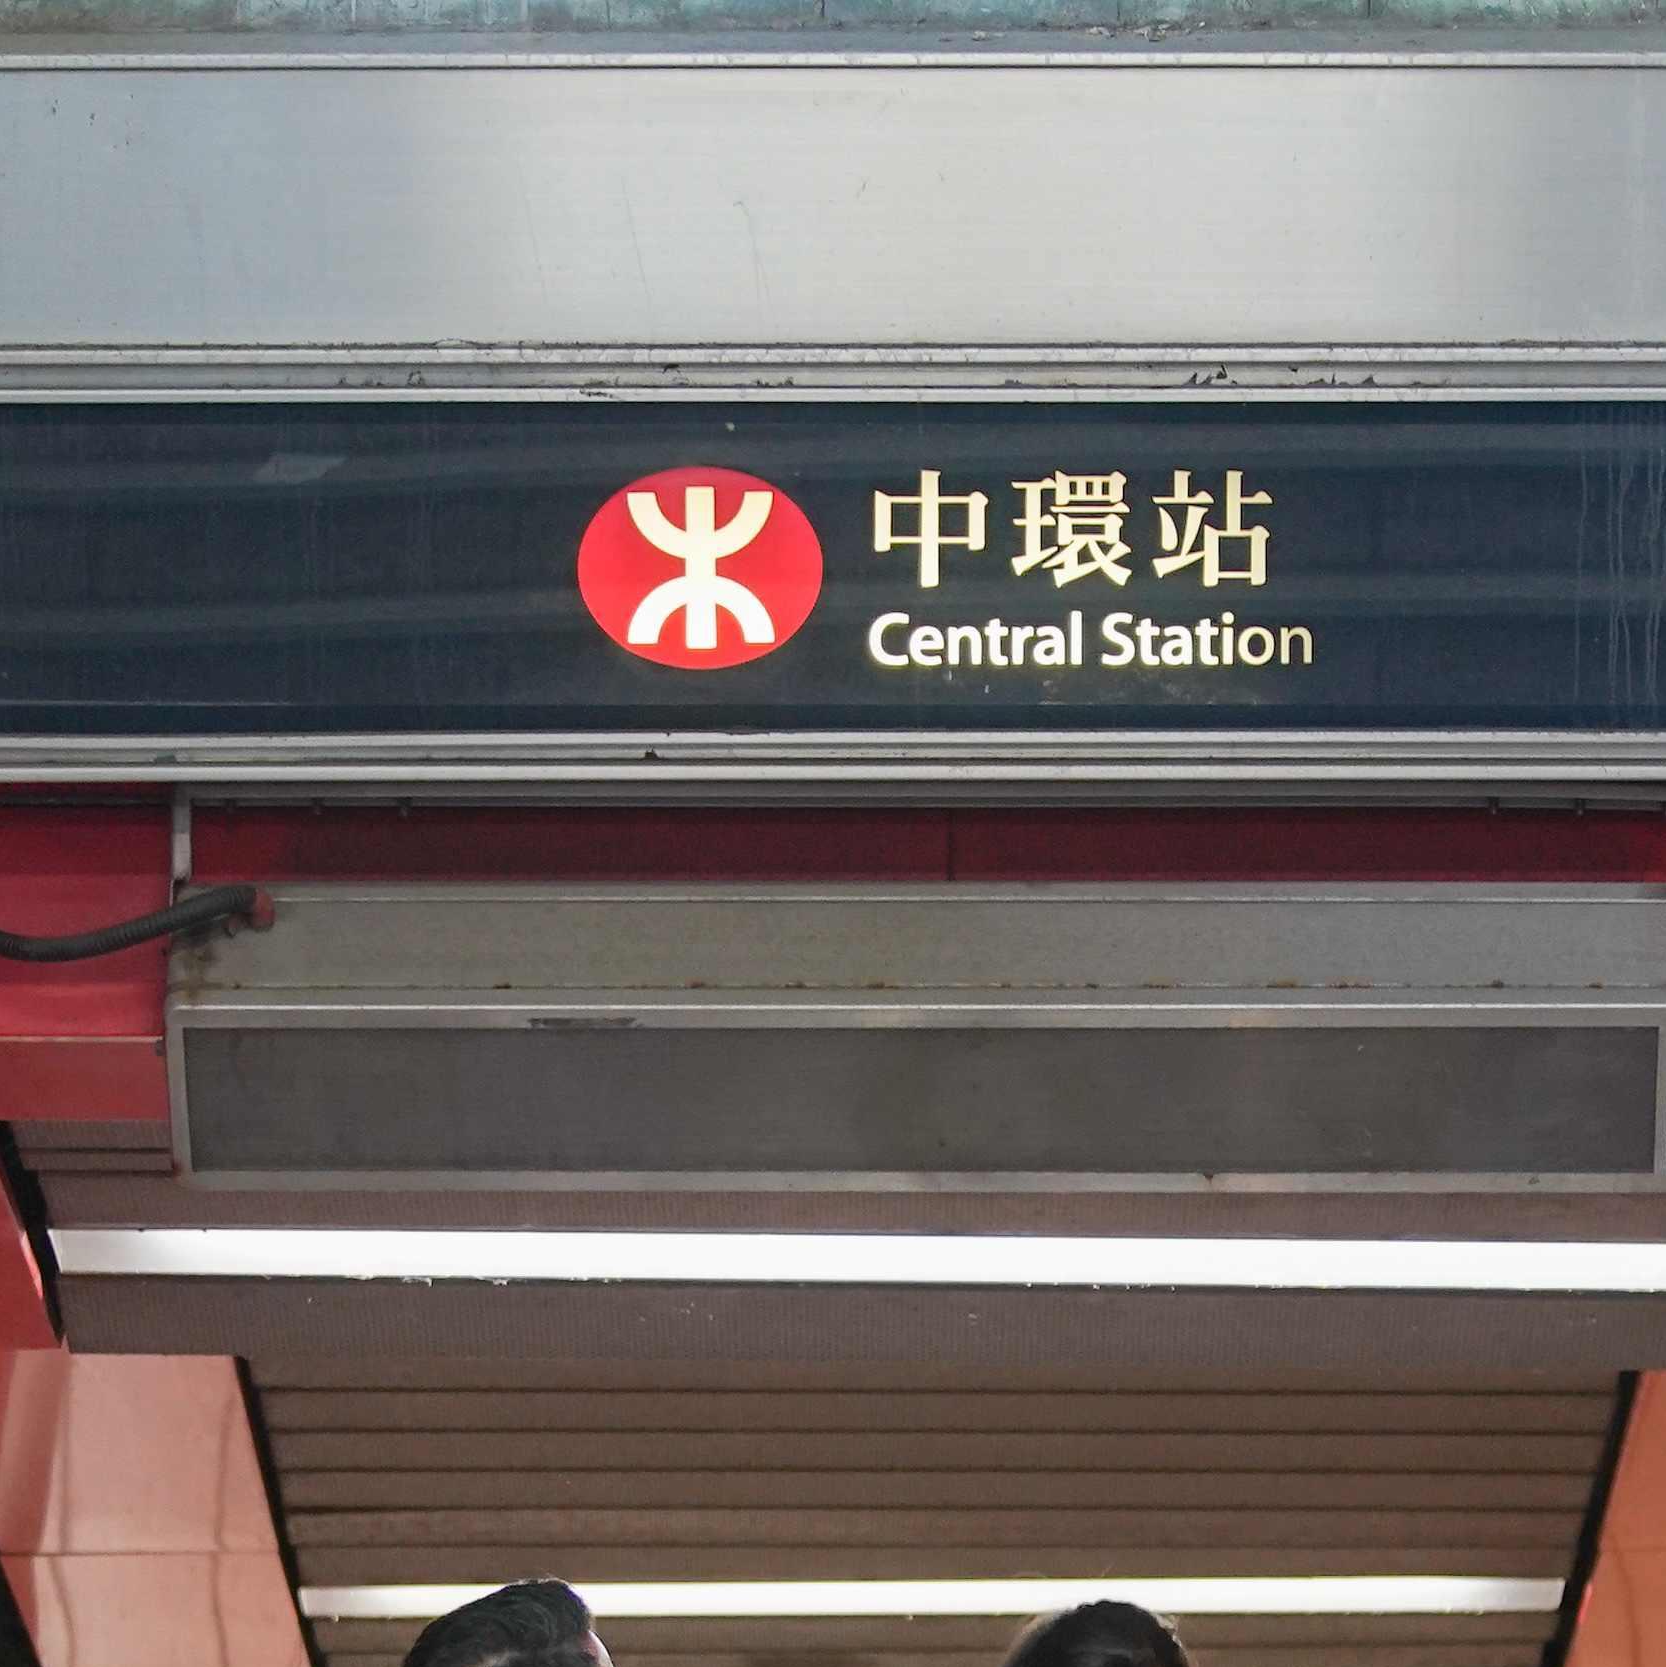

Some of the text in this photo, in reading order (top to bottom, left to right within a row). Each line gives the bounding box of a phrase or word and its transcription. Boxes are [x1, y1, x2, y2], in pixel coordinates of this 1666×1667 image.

[873, 469, 1273, 588] 中環站
[867, 610, 1313, 667] Central Station
